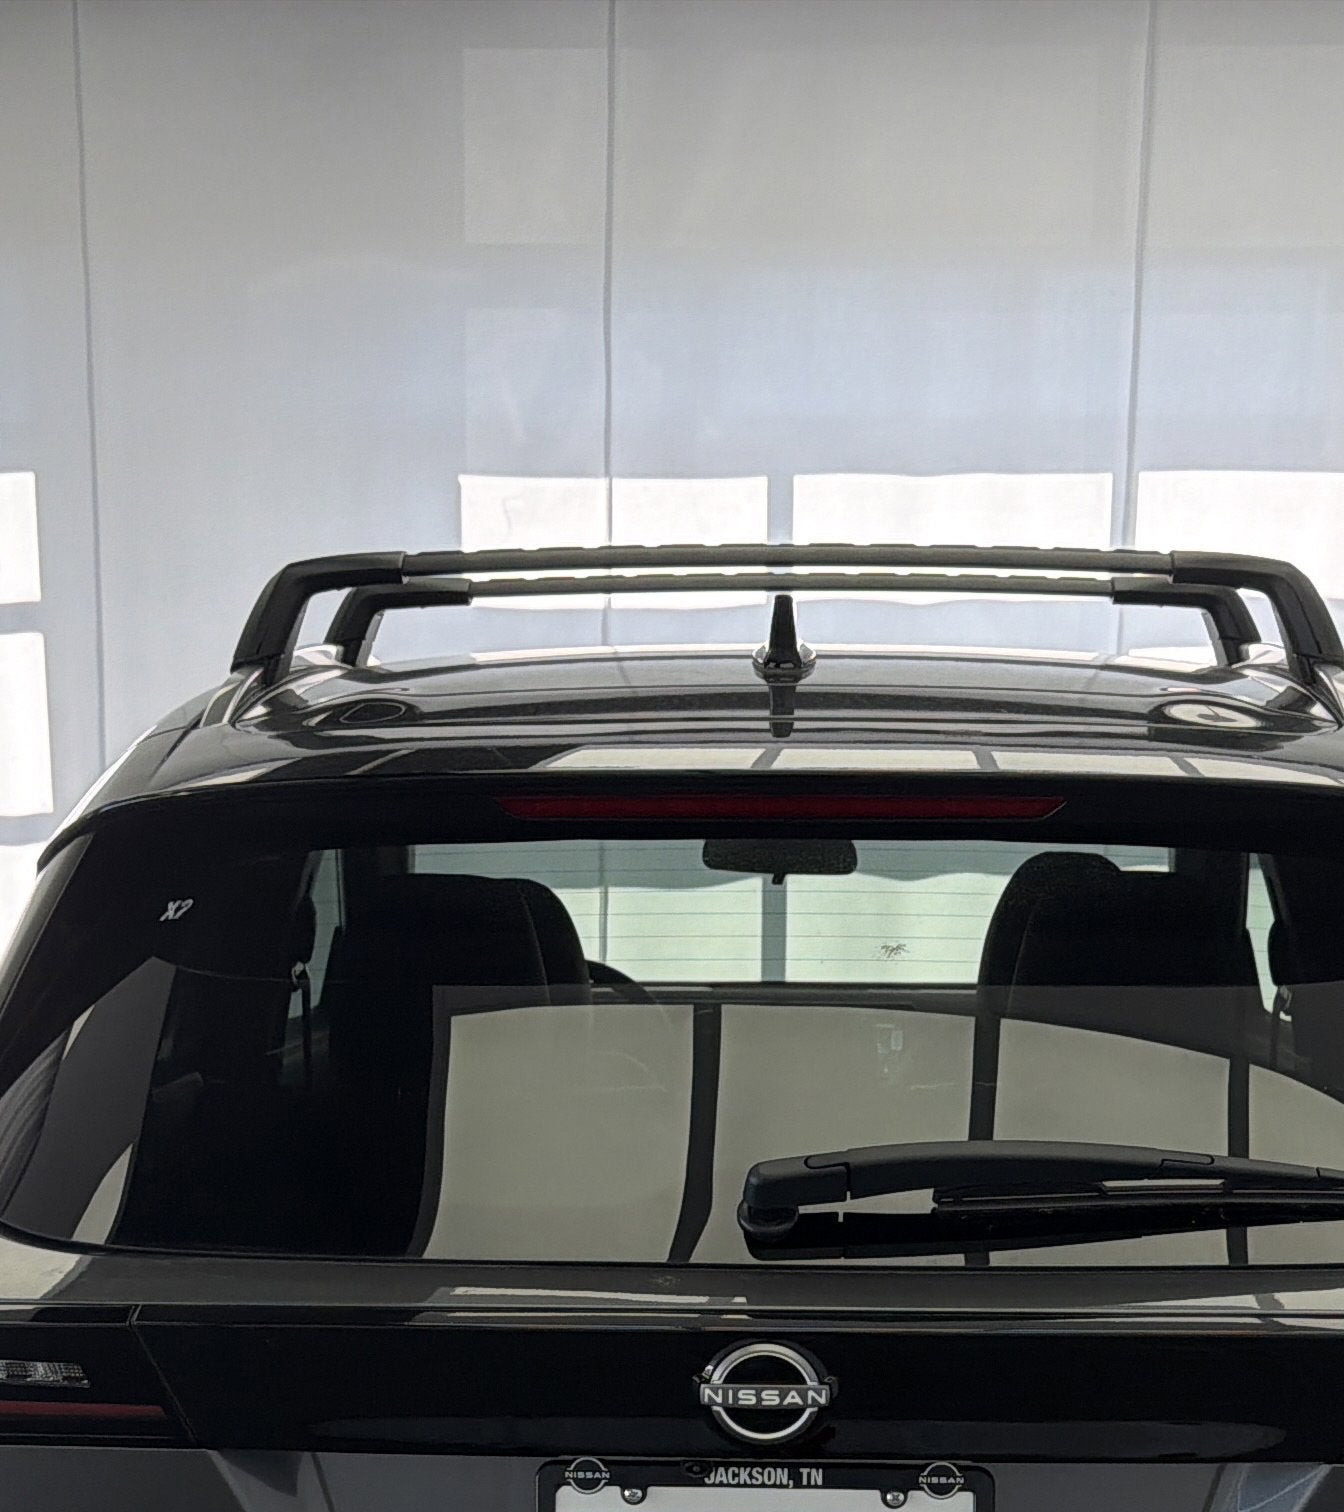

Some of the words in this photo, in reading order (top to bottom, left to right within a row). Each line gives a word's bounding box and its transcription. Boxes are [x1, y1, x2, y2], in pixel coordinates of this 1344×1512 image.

[703, 1387, 828, 1406] NISSAN
[565, 1470, 610, 1479] NISSAN
[704, 1466, 794, 1488] JACKSON,
[799, 1468, 823, 1486] TN
[919, 1475, 964, 1484] NISSAN
